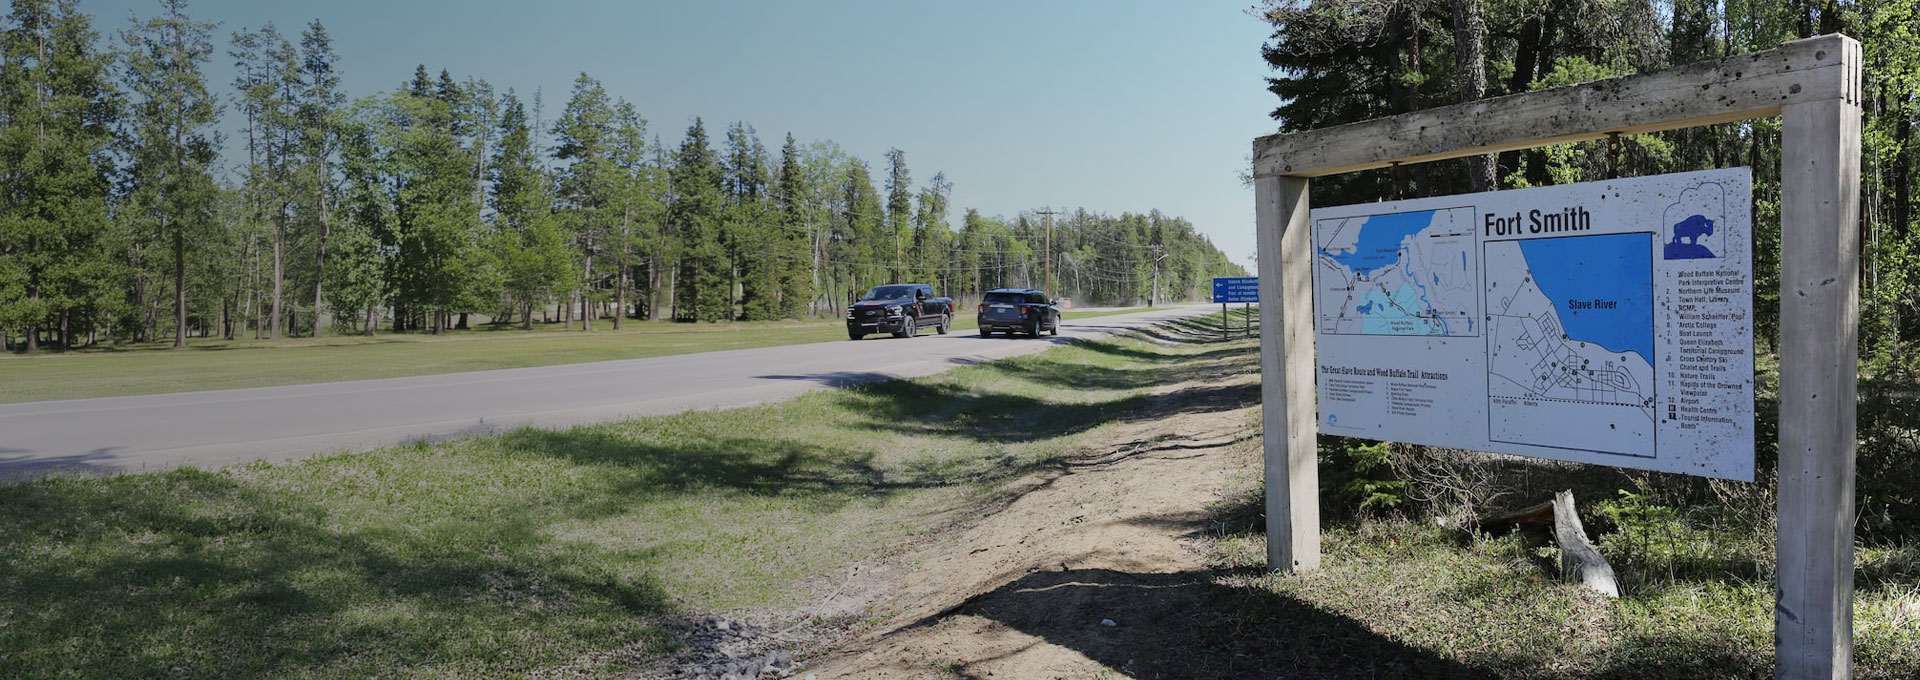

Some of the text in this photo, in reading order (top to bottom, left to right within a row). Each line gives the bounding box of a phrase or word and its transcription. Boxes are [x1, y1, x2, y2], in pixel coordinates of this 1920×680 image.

[1485, 206, 1590, 236] Fort Smith
[1569, 299, 1617, 309] Slave River
[1330, 366, 1340, 374] Great
[1342, 366, 1352, 375] Slave
[1354, 367, 1366, 376] Route
[1367, 368, 1375, 376] and
[1376, 368, 1388, 377] Wood
[1390, 369, 1406, 378] Buffalo
[1407, 370, 1418, 379] Trail
[1421, 371, 1448, 380] Attractions
